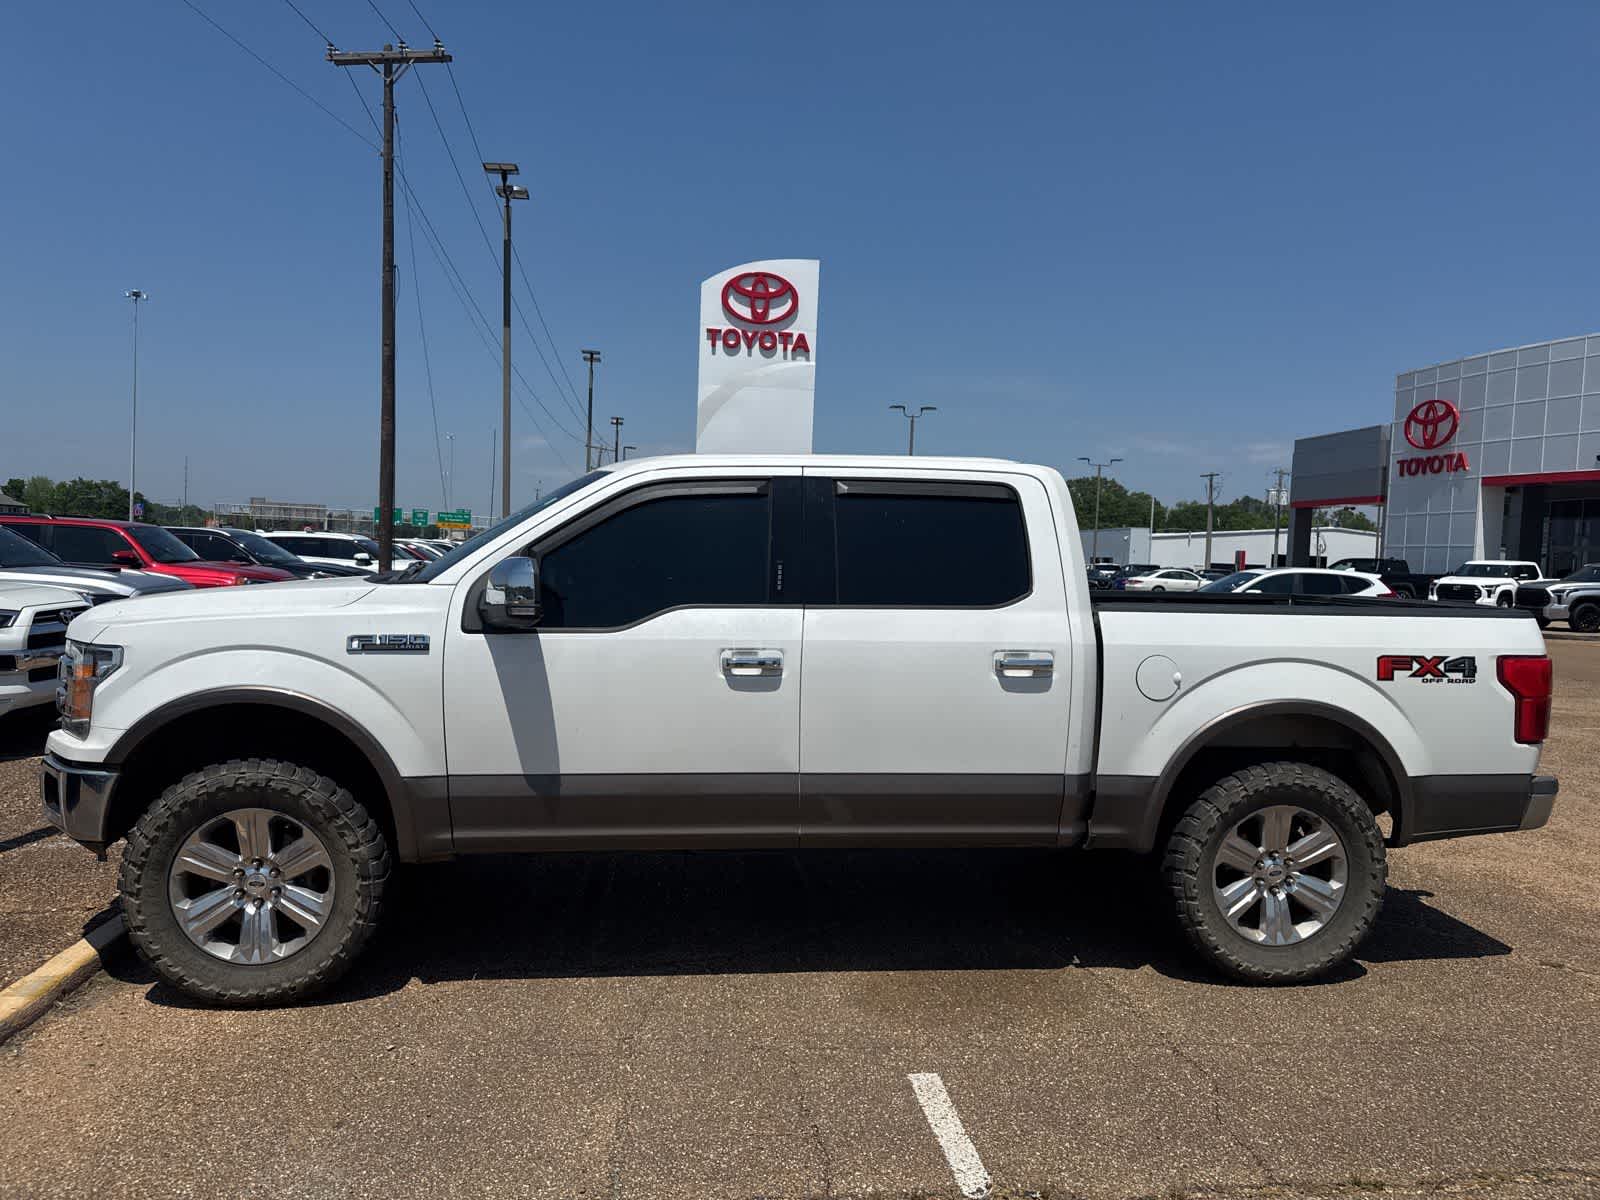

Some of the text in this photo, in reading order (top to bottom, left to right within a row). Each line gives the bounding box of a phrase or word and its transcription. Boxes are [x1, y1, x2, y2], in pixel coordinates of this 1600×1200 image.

[706, 328, 811, 353] TOYOTA
[1397, 452, 1470, 477] TOYOTA
[1377, 655, 1477, 681] FX4
